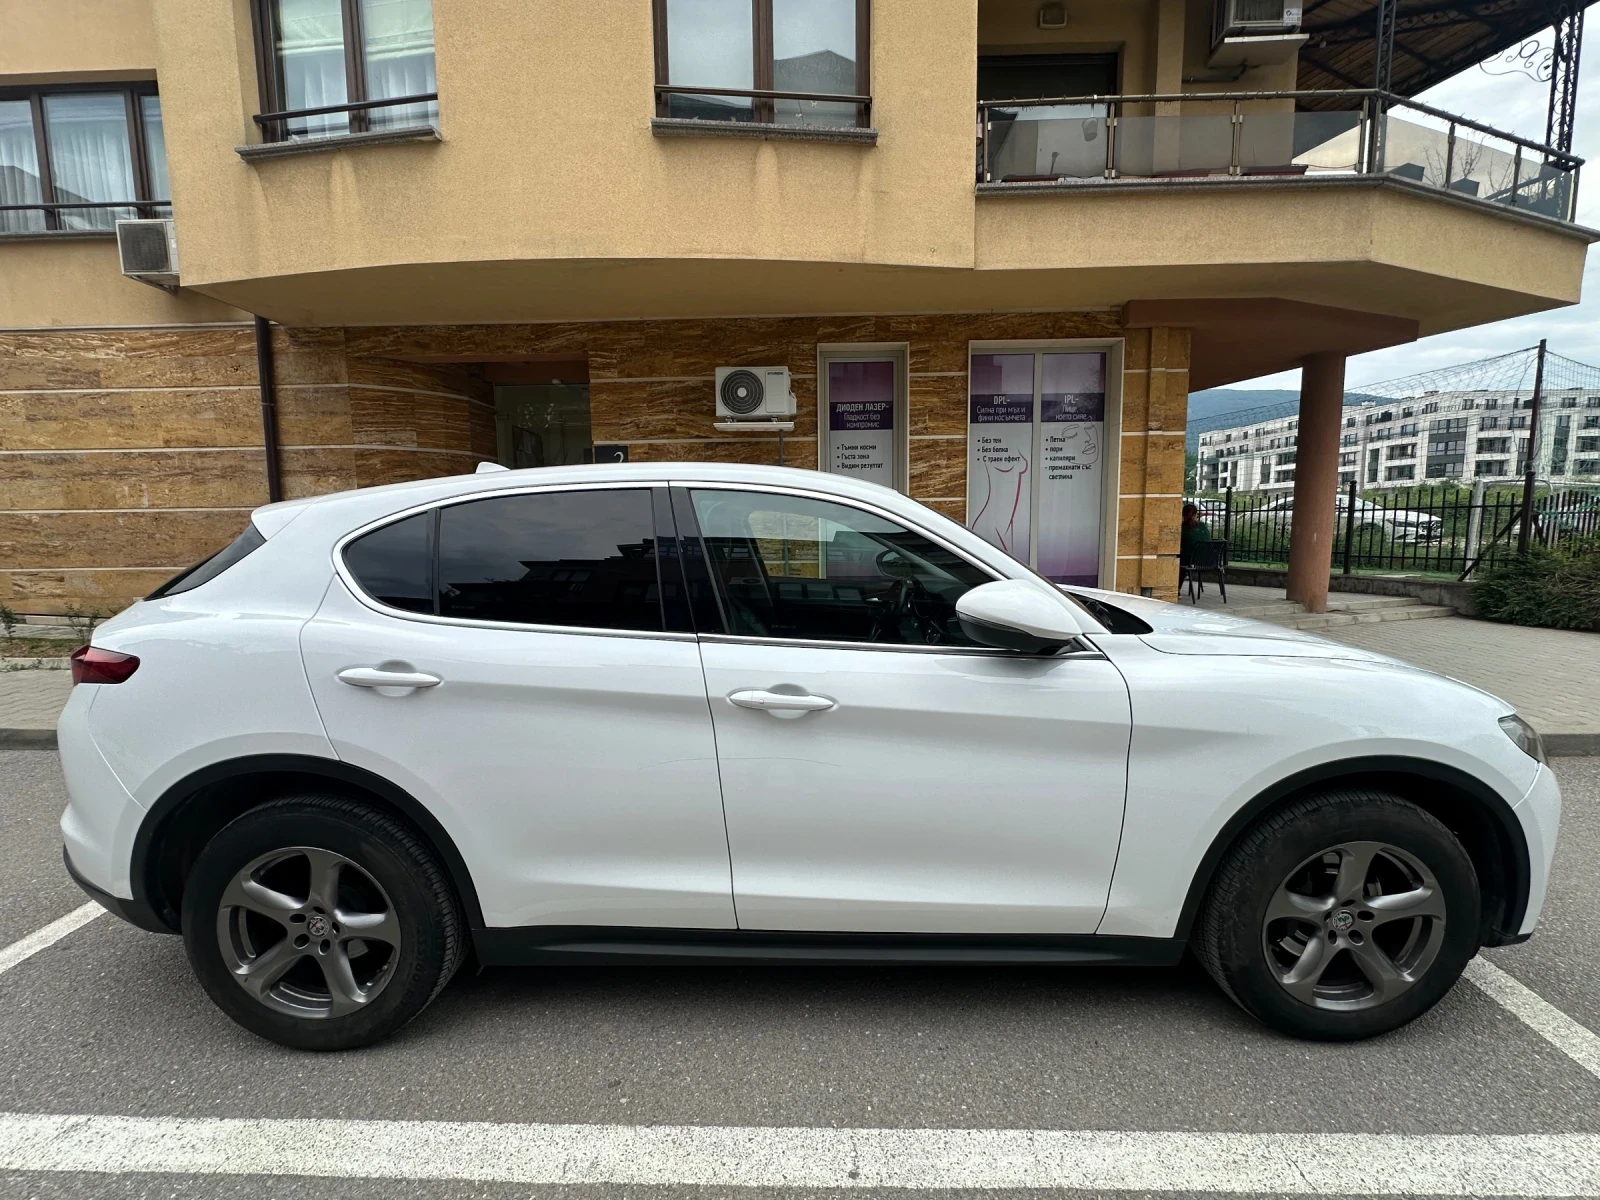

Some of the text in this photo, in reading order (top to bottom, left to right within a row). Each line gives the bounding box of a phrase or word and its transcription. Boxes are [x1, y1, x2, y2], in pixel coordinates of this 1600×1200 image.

[994, 396, 1010, 404] DPL-
[1064, 395, 1078, 403] IPL-
[836, 403, 889, 412] ДИОДЕН ЛАЗЕР-
[978, 414, 993, 422] фини
